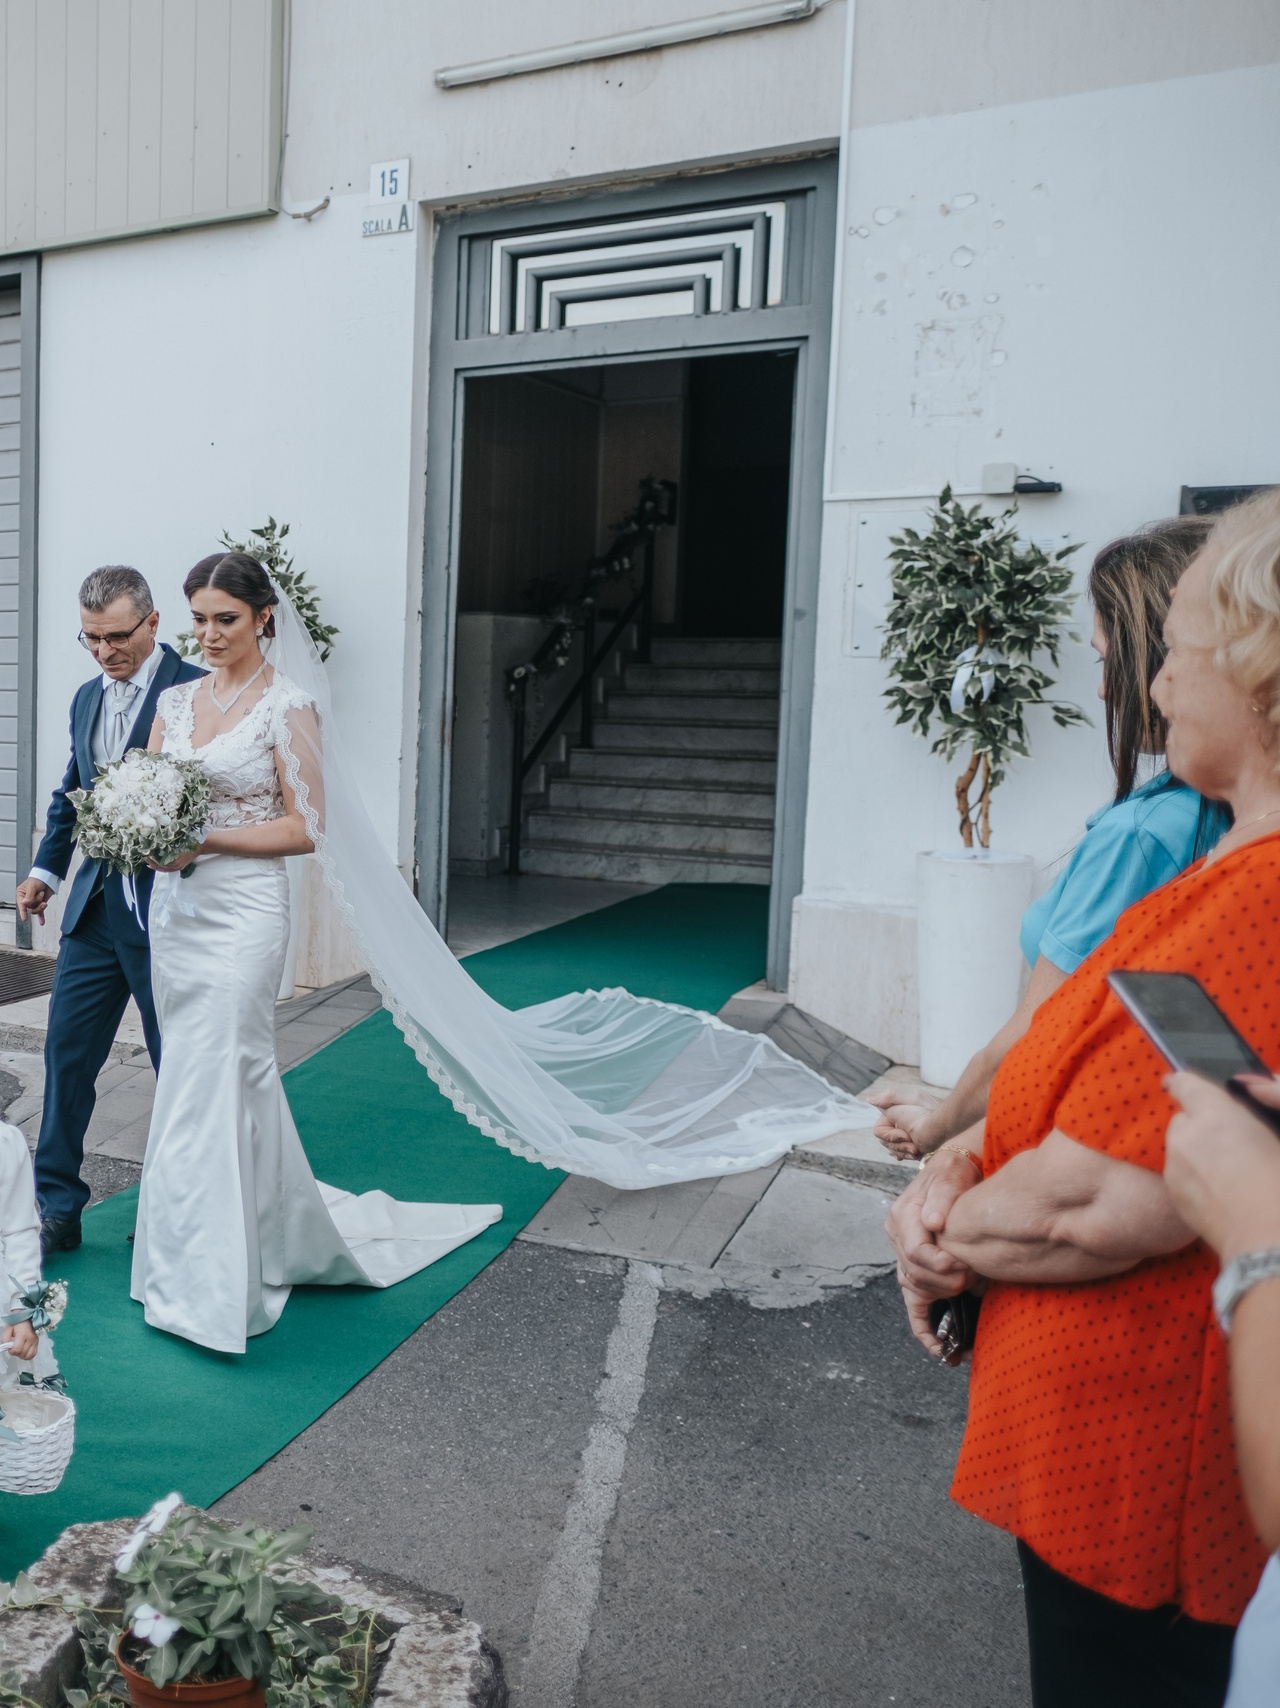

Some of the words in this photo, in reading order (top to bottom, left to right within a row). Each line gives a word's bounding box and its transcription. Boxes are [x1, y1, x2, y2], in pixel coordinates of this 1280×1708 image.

[381, 168, 398, 197] 15
[362, 217, 393, 234] SCALA
[398, 203, 409, 231] A
